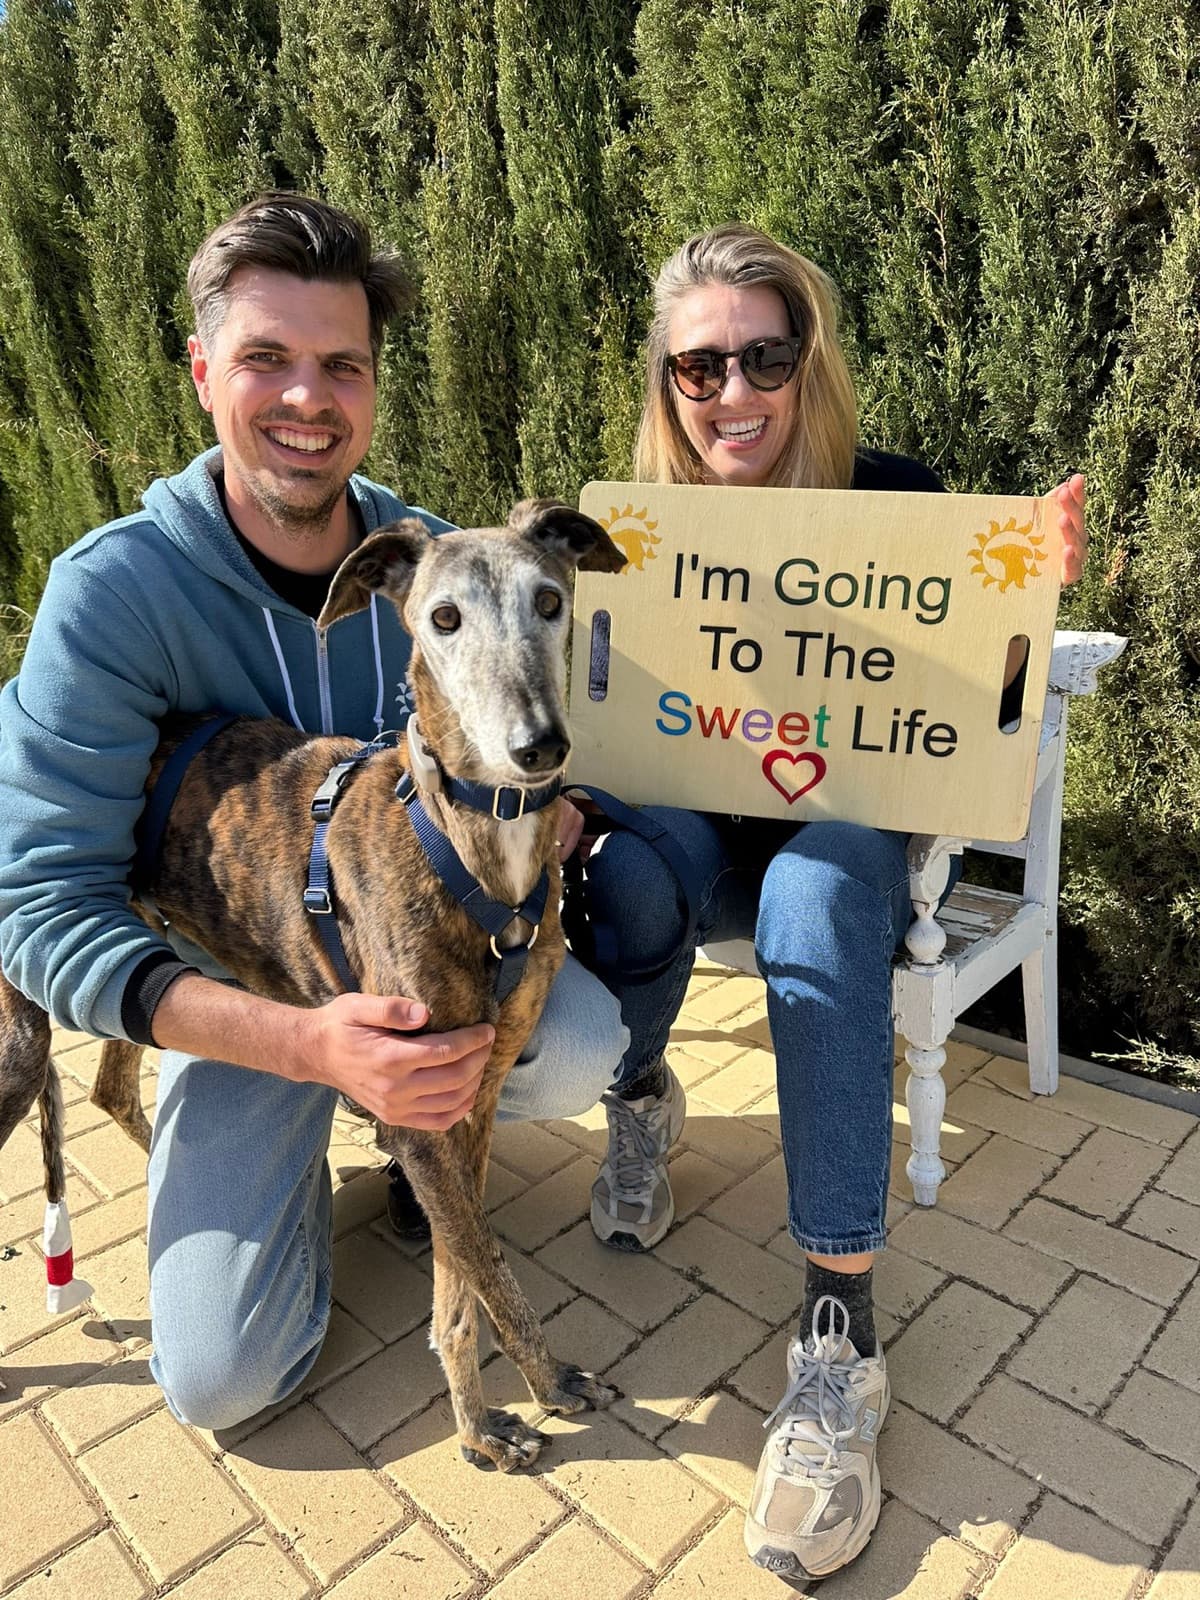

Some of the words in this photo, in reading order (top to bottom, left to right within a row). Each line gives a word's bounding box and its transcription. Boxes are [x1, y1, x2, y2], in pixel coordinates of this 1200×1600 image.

[673, 553, 750, 602] I'm
[774, 558, 952, 625] Going
[699, 625, 763, 673] To
[784, 630, 895, 682] The
[656, 690, 831, 748] Sweet
[852, 705, 958, 757] Life
